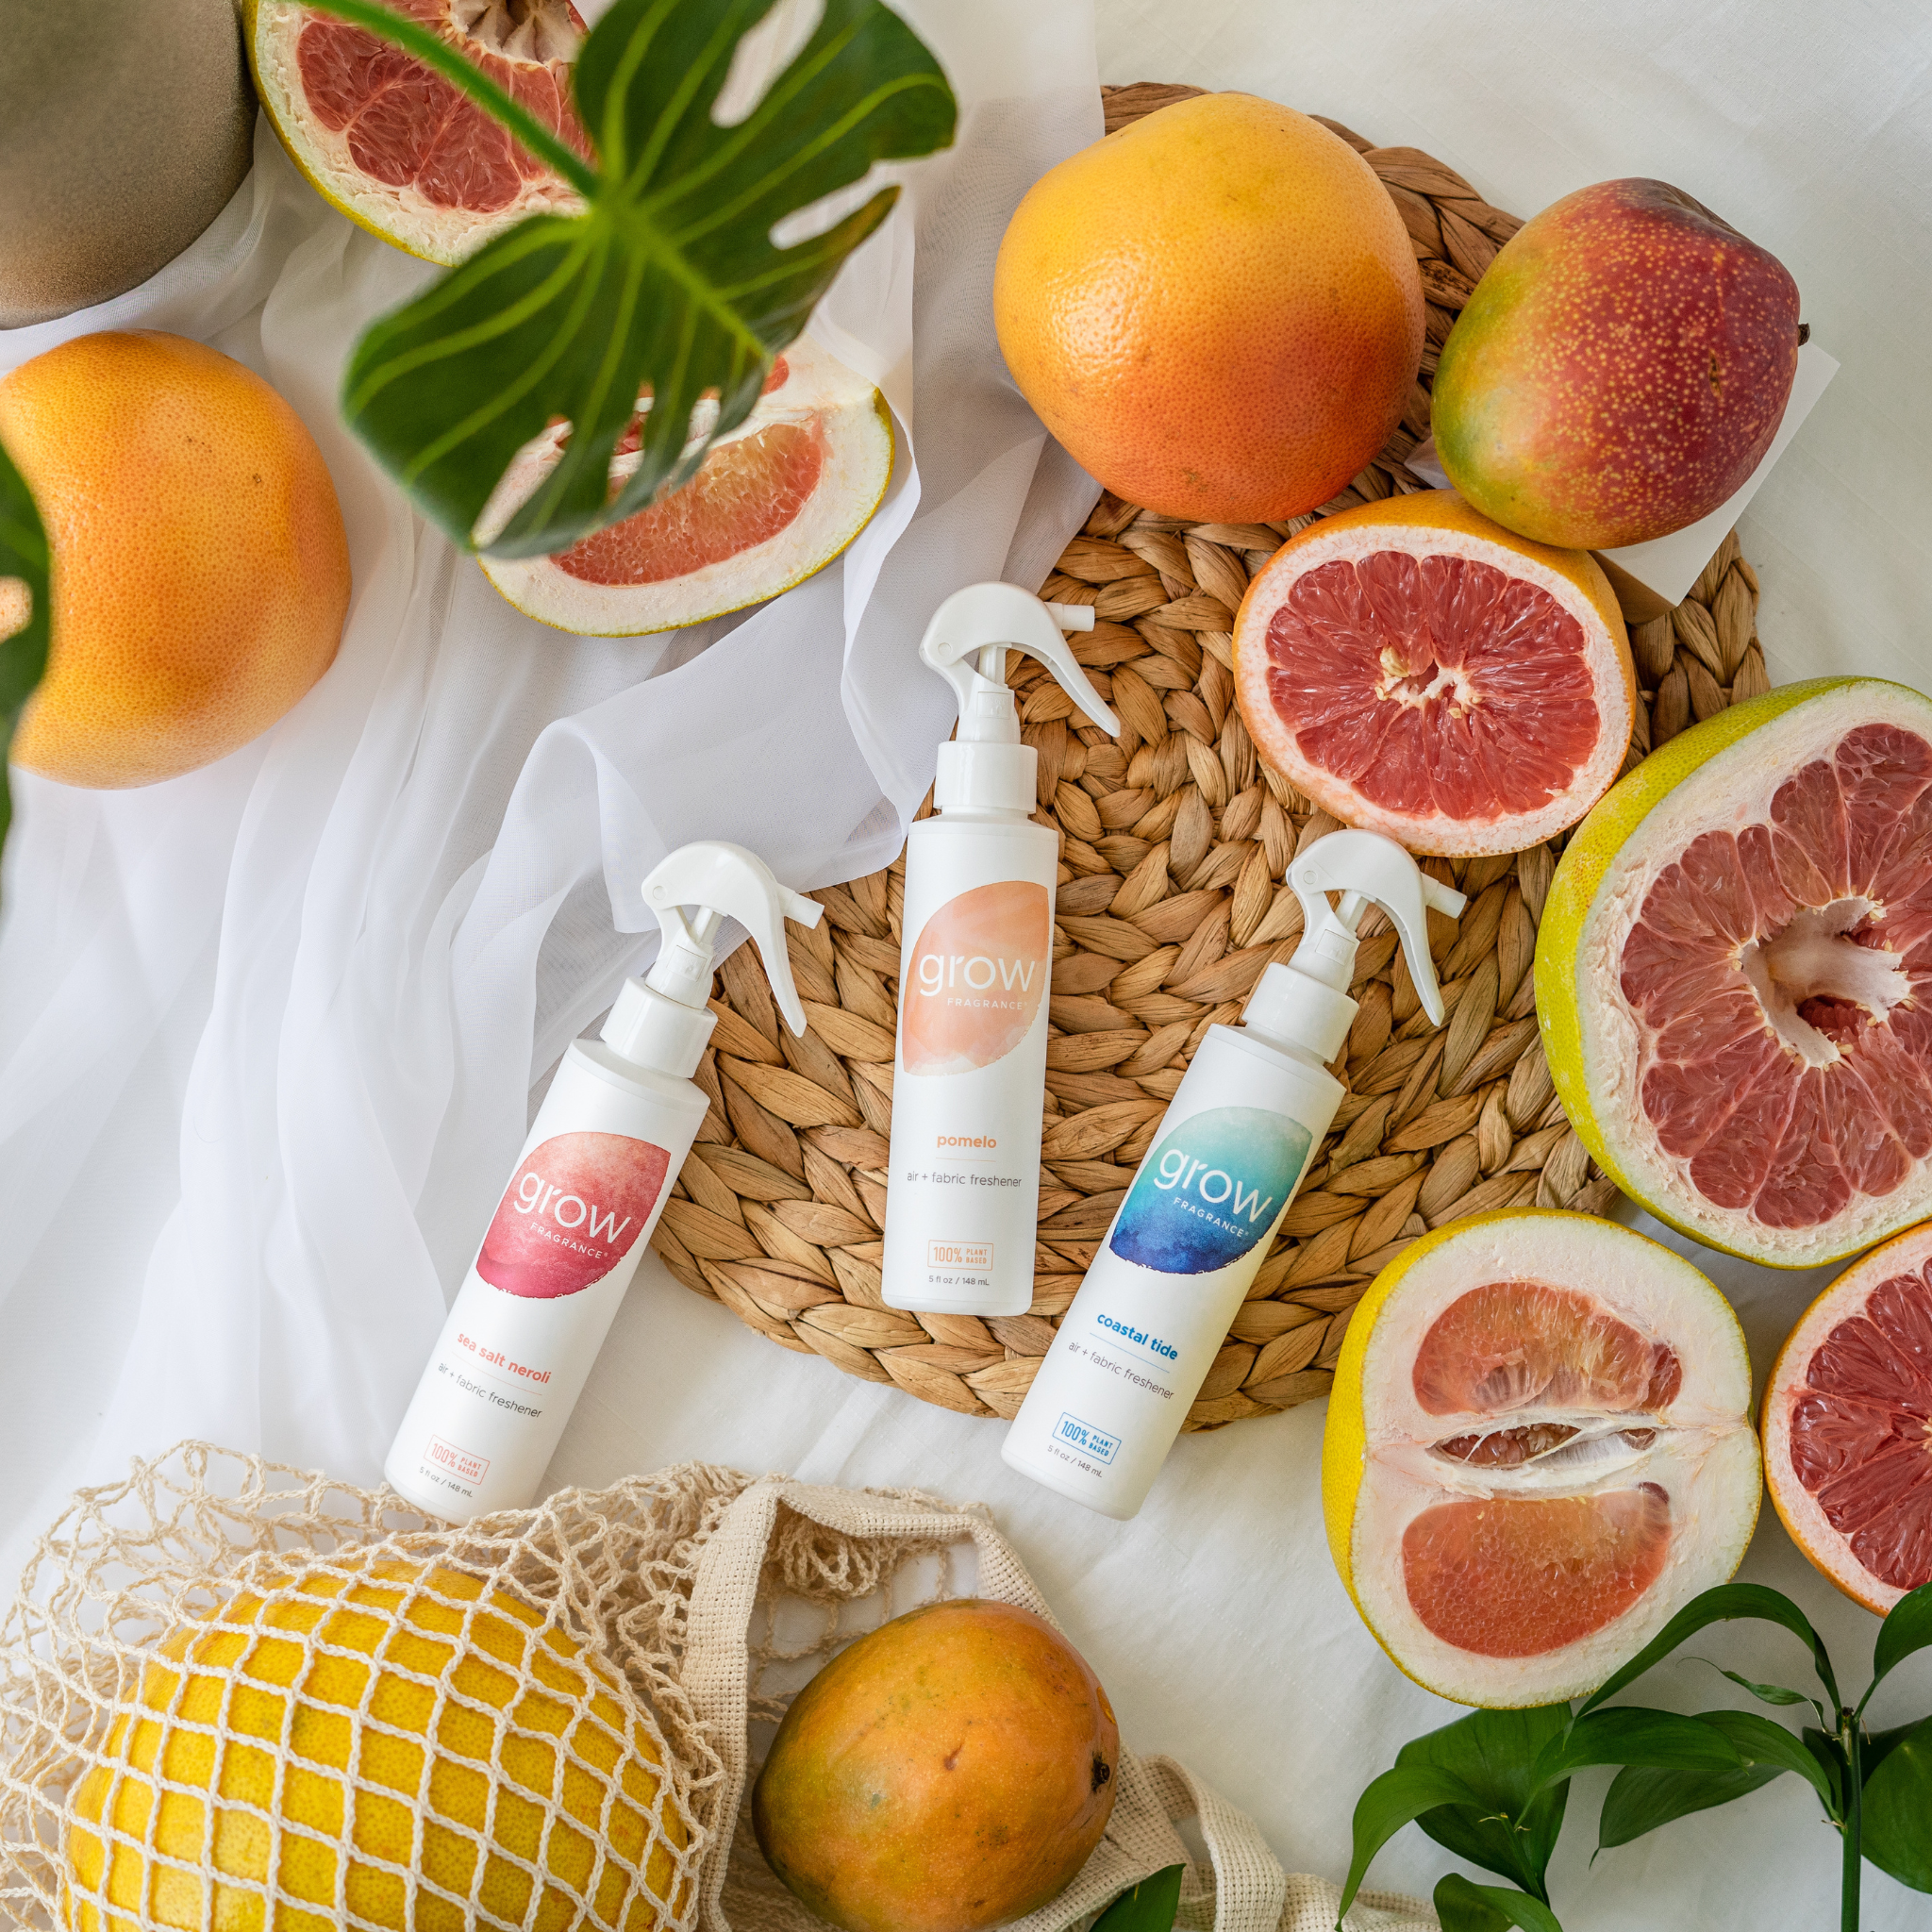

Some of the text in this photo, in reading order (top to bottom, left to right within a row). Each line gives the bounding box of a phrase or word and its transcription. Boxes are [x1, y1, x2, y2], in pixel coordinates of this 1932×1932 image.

[919, 954, 1036, 997] grow
[937, 1135, 997, 1149] pomelo
[907, 1171, 919, 1181] air
[932, 1172, 966, 1185] fabric
[970, 1174, 1023, 1188] freshener
[1153, 1149, 1273, 1223] grow
[513, 1172, 631, 1244] grow
[933, 1246, 962, 1263] 100%
[966, 1248, 988, 1257] PLANT
[955, 1276, 960, 1285] /
[1097, 1314, 1178, 1360] coastal tide
[458, 1333, 552, 1384] sea salt neroli
[1068, 1341, 1080, 1353] air
[1090, 1351, 1123, 1374] fabric
[1124, 1369, 1174, 1400] freshener
[438, 1362, 449, 1374] air
[456, 1374, 487, 1398] fabric
[489, 1391, 542, 1418] freshener
[1061, 1421, 1090, 1445] 100%
[1092, 1435, 1113, 1449] PLANT
[431, 1442, 458, 1468] 100%
[1089, 1442, 1109, 1457] BASED
[458, 1464, 478, 1477] BASED
[460, 1457, 482, 1471] PLANT
[1059, 1453, 1070, 1461] oz
[1077, 1460, 1091, 1472] 148
[1091, 1468, 1103, 1477] mL
[425, 1469, 431, 1477] fl
[430, 1474, 440, 1483] oz
[447, 1481, 460, 1492] 148
[461, 1488, 473, 1498] mL
